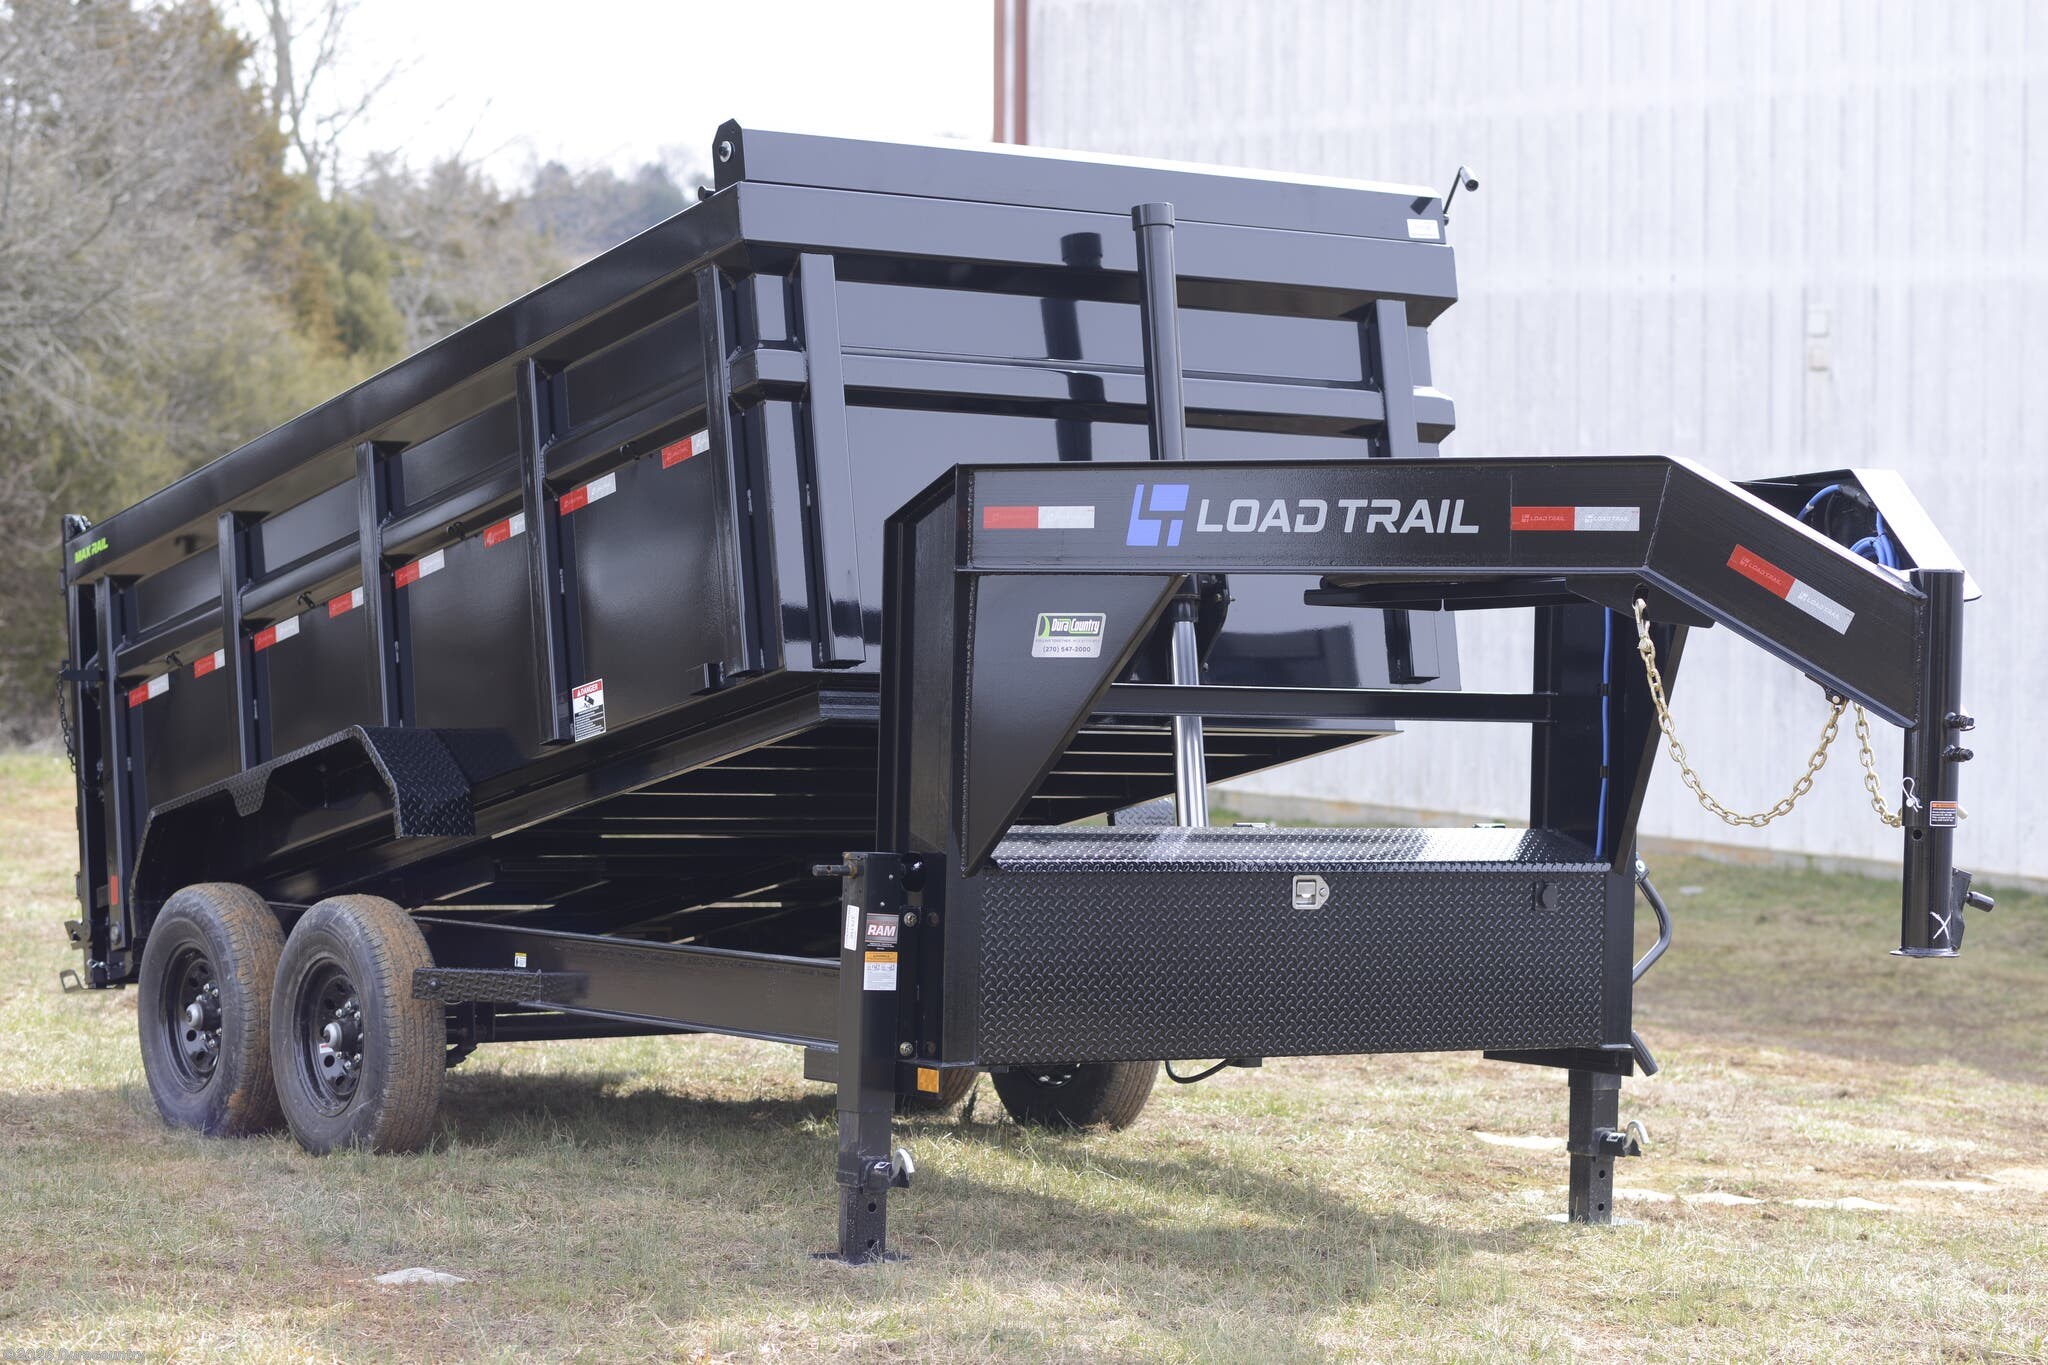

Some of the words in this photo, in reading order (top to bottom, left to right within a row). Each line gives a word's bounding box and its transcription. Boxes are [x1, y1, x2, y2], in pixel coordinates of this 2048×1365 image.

[1197, 498, 1328, 533] LOAD
[1337, 498, 1480, 534] TRAIL
[75, 543, 91, 563] MAX
[91, 537, 109, 556] RAIL
[1051, 618, 1069, 631] Dura
[1071, 618, 1100, 634] Country
[867, 924, 897, 937] RAM
